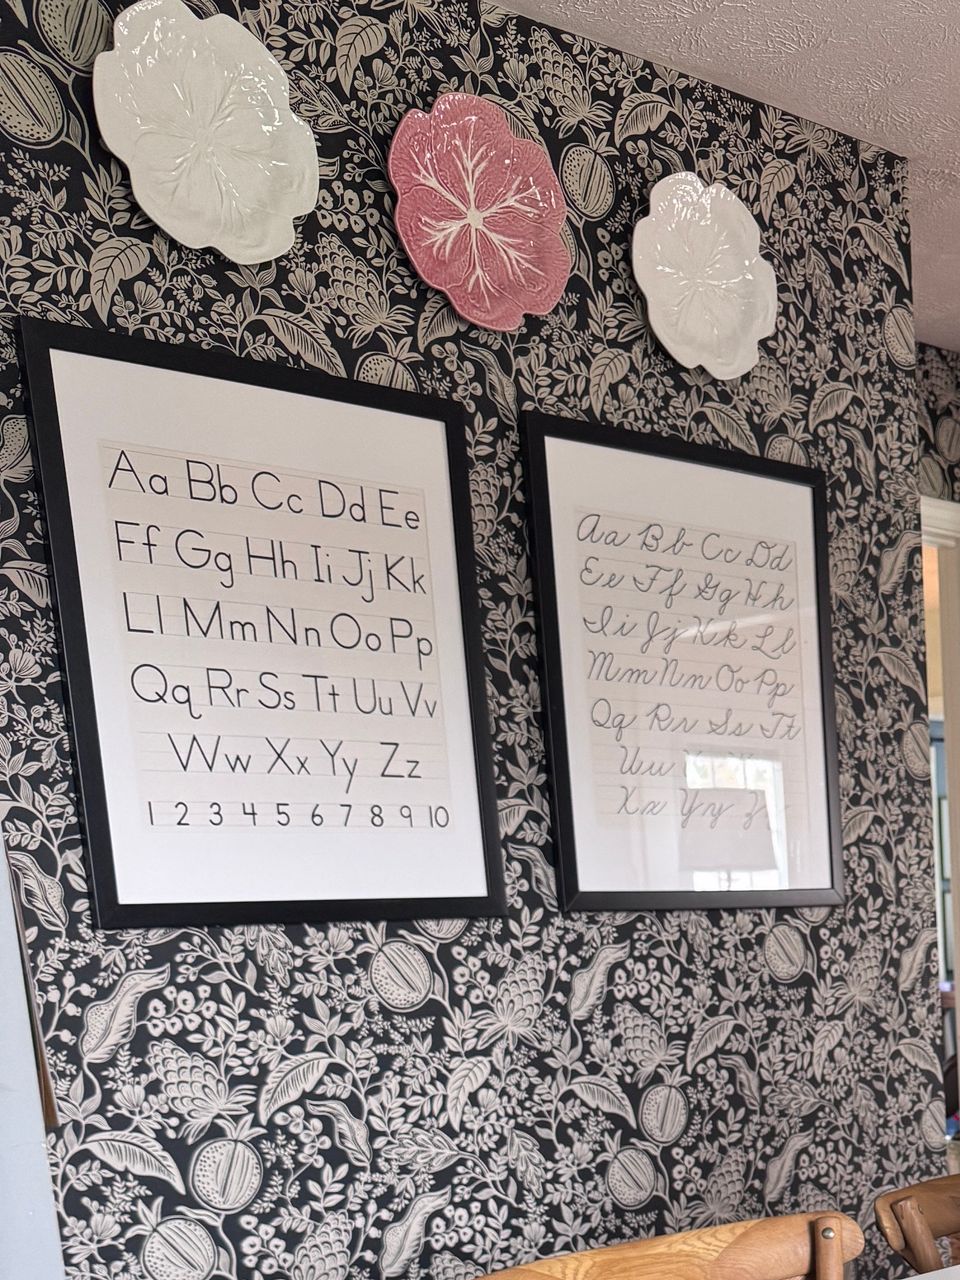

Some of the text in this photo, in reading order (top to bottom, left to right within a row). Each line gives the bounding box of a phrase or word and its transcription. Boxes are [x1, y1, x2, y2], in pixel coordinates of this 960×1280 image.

[108, 450, 419, 529] Aa Bb Cc Dd Ee
[115, 520, 426, 603] Ff Gg Hh Ii Jj Kk
[123, 592, 432, 671] Ll Mm Nn Oo Pp
[131, 664, 436, 719] Qq Rr Ss Tt Uu Vv
[168, 733, 422, 794] Ww Xx Yy Zz
[148, 801, 449, 828] 1 2 3 4 5 6 7 8 9 10
